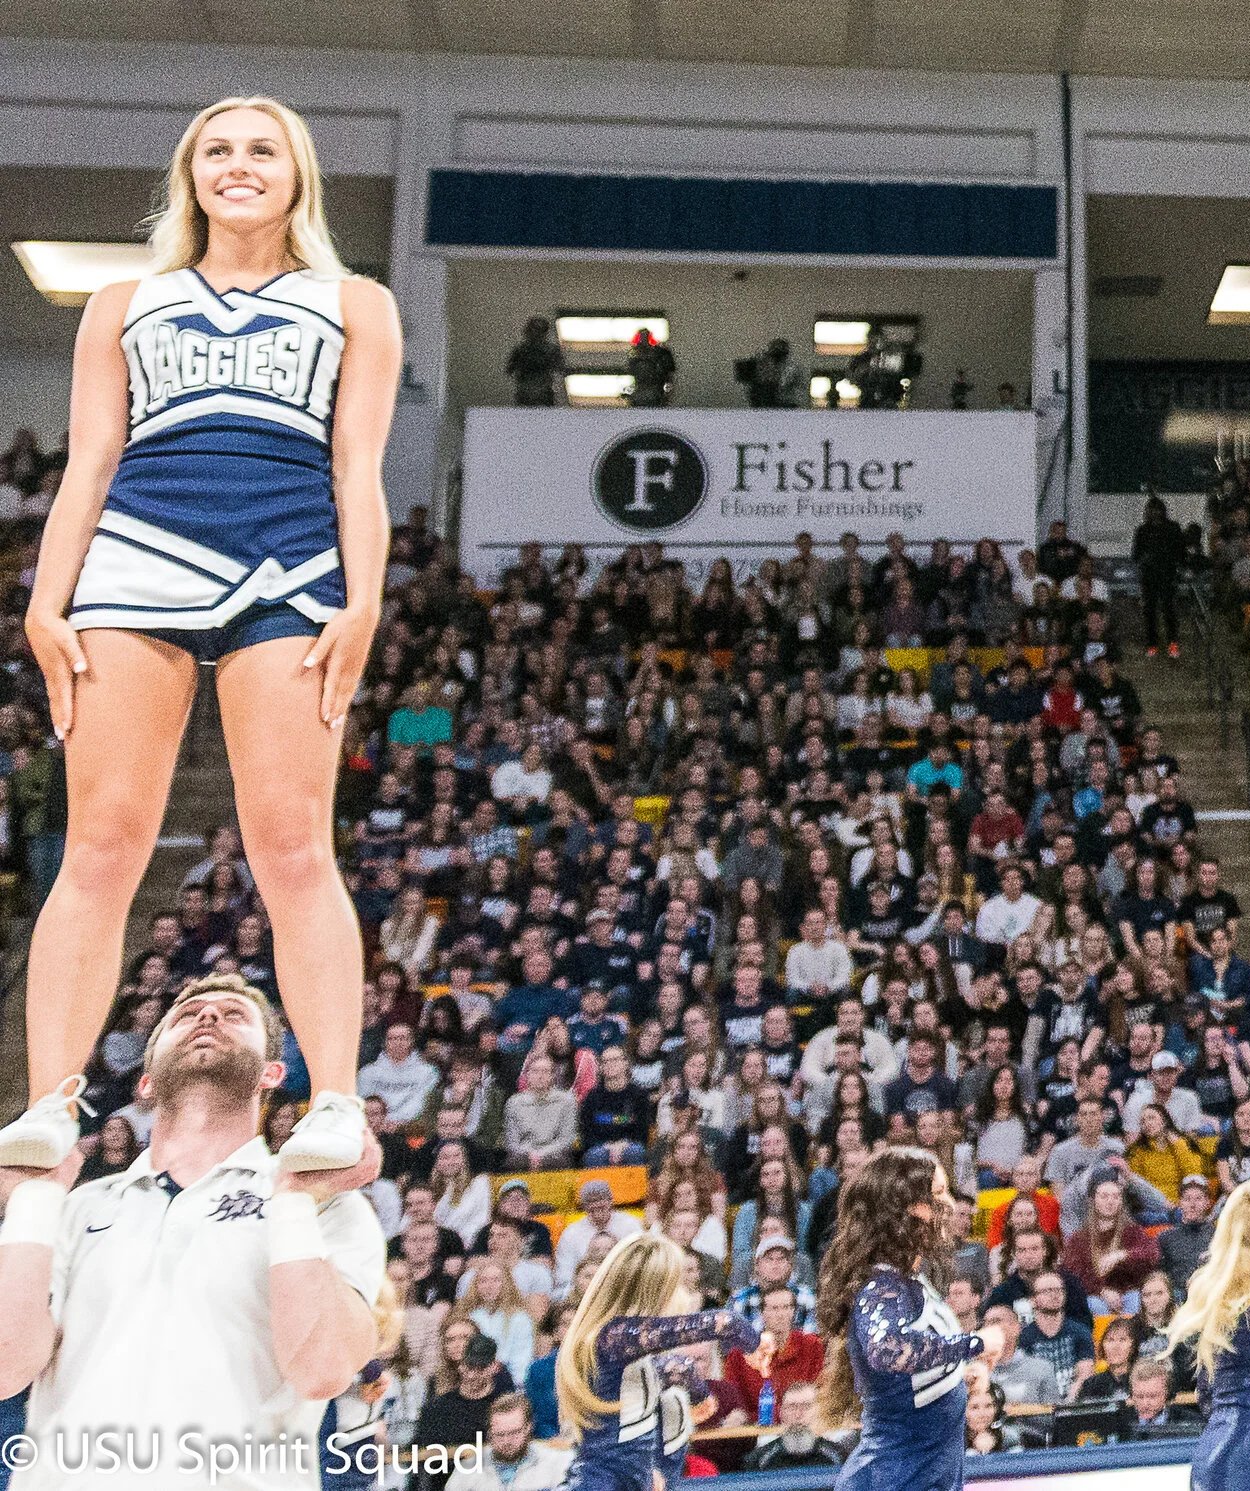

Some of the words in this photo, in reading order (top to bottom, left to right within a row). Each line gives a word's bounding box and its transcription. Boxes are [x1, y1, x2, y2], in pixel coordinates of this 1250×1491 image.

[151, 322, 302, 405] AGGIES
[624, 449, 679, 511] F
[730, 438, 916, 493] Fisher
[720, 498, 789, 518] Home
[796, 498, 926, 521] Furnishings
